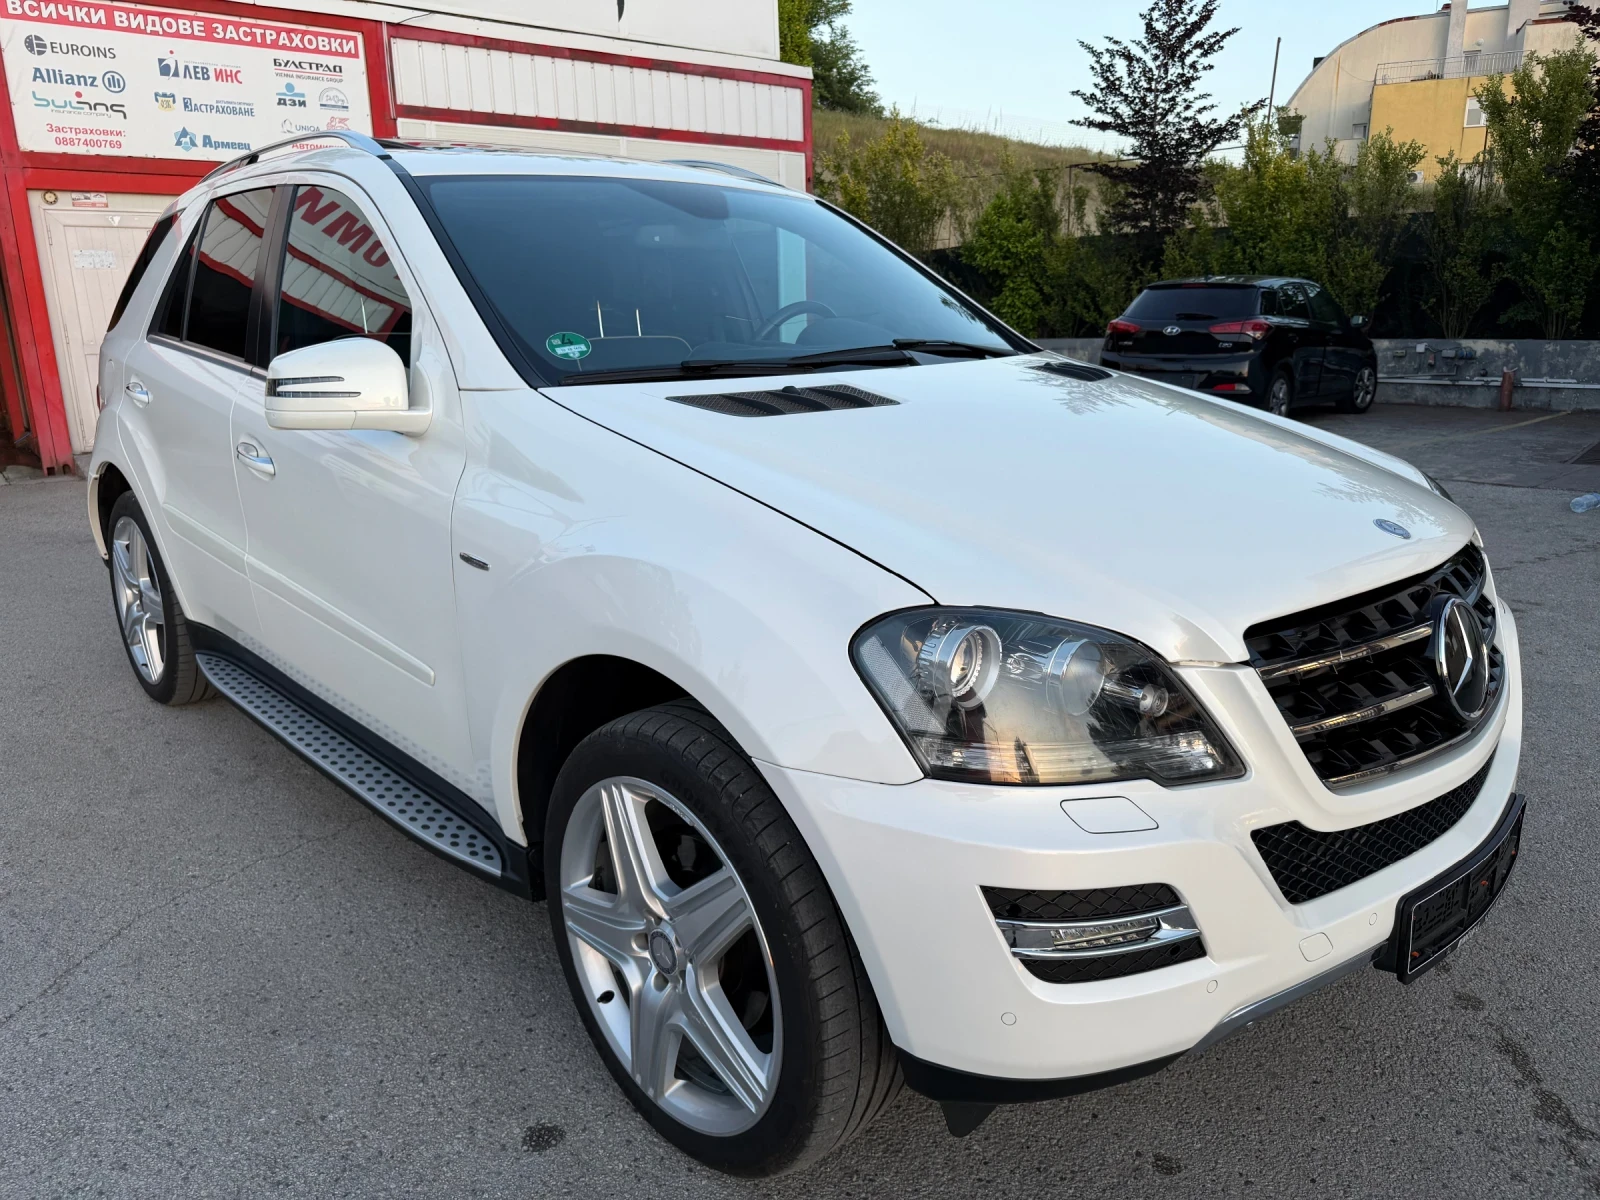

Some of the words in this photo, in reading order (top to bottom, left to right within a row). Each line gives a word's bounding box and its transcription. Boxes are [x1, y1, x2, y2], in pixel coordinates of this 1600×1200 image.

[6, 0, 107, 25] ВСИЧКИ
[113, 10, 206, 37] ВИДОВЕ
[211, 23, 356, 54] ЗАСТРАХОВКИ
[50, 41, 117, 60] EUROINS
[273, 57, 343, 73] БУЛСТРАД
[32, 67, 99, 88] Allianz
[183, 64, 211, 81] ЛЕВ
[213, 67, 243, 84] ИНС
[275, 71, 295, 79] VIENNA
[295, 73, 326, 83] INSURANCE
[325, 76, 344, 84] GROUP
[276, 97, 307, 108] ДЗИ
[83, 110, 112, 119] company
[46, 122, 127, 138] Застраховки:
[54, 136, 122, 149] 0887400769
